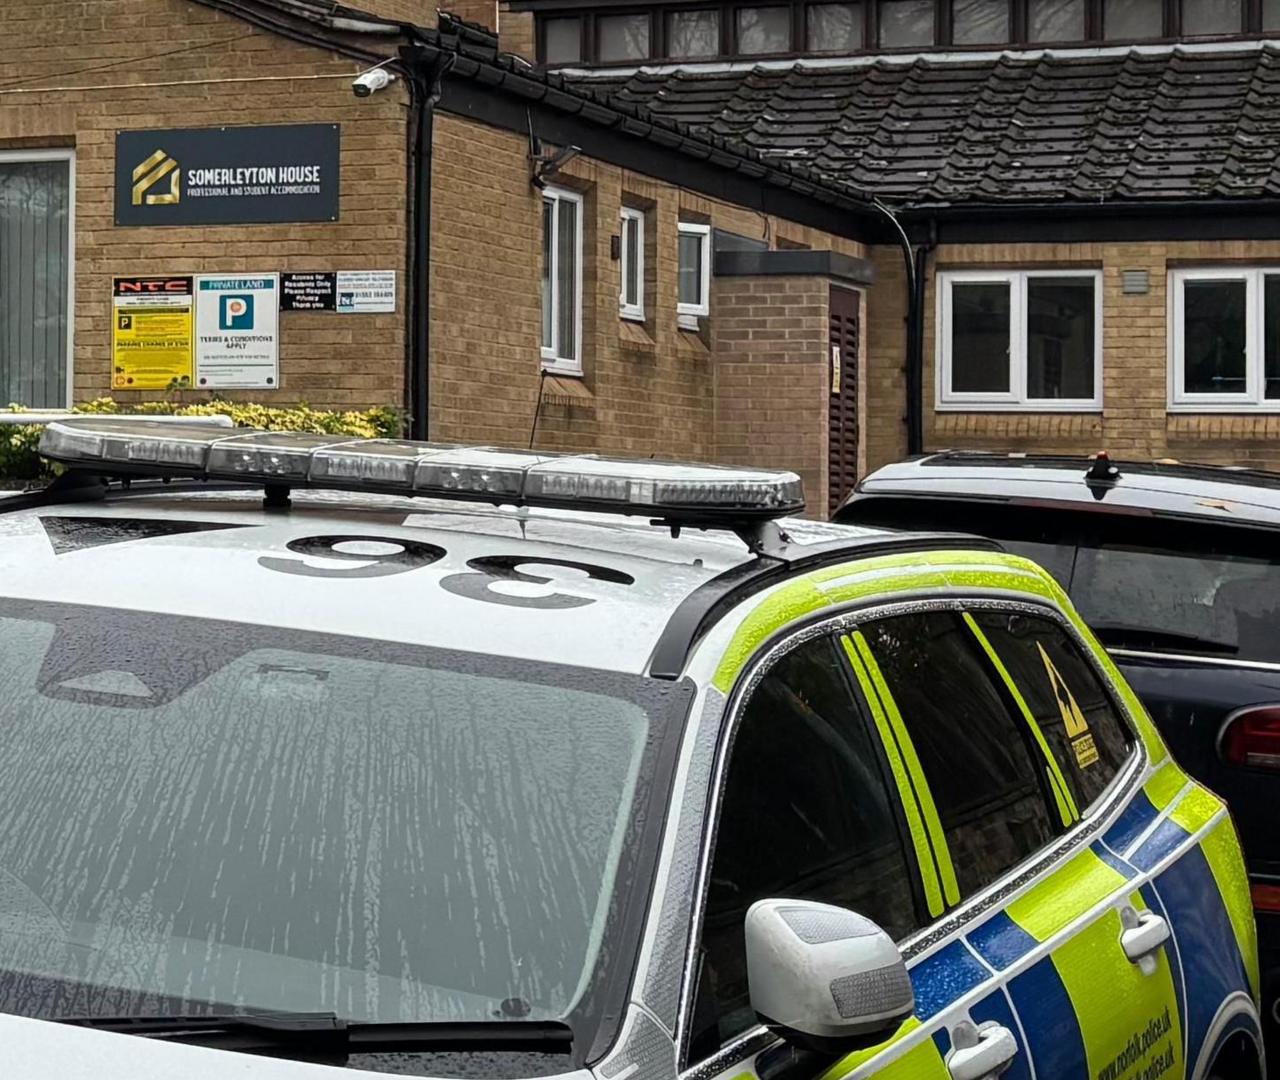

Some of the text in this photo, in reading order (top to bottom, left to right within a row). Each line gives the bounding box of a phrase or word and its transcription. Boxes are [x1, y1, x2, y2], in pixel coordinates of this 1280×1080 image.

[188, 166, 320, 185] SOMERLEYTON HOUSE
[209, 280, 264, 289] PRIVATE LAND
[226, 298, 247, 326] P
